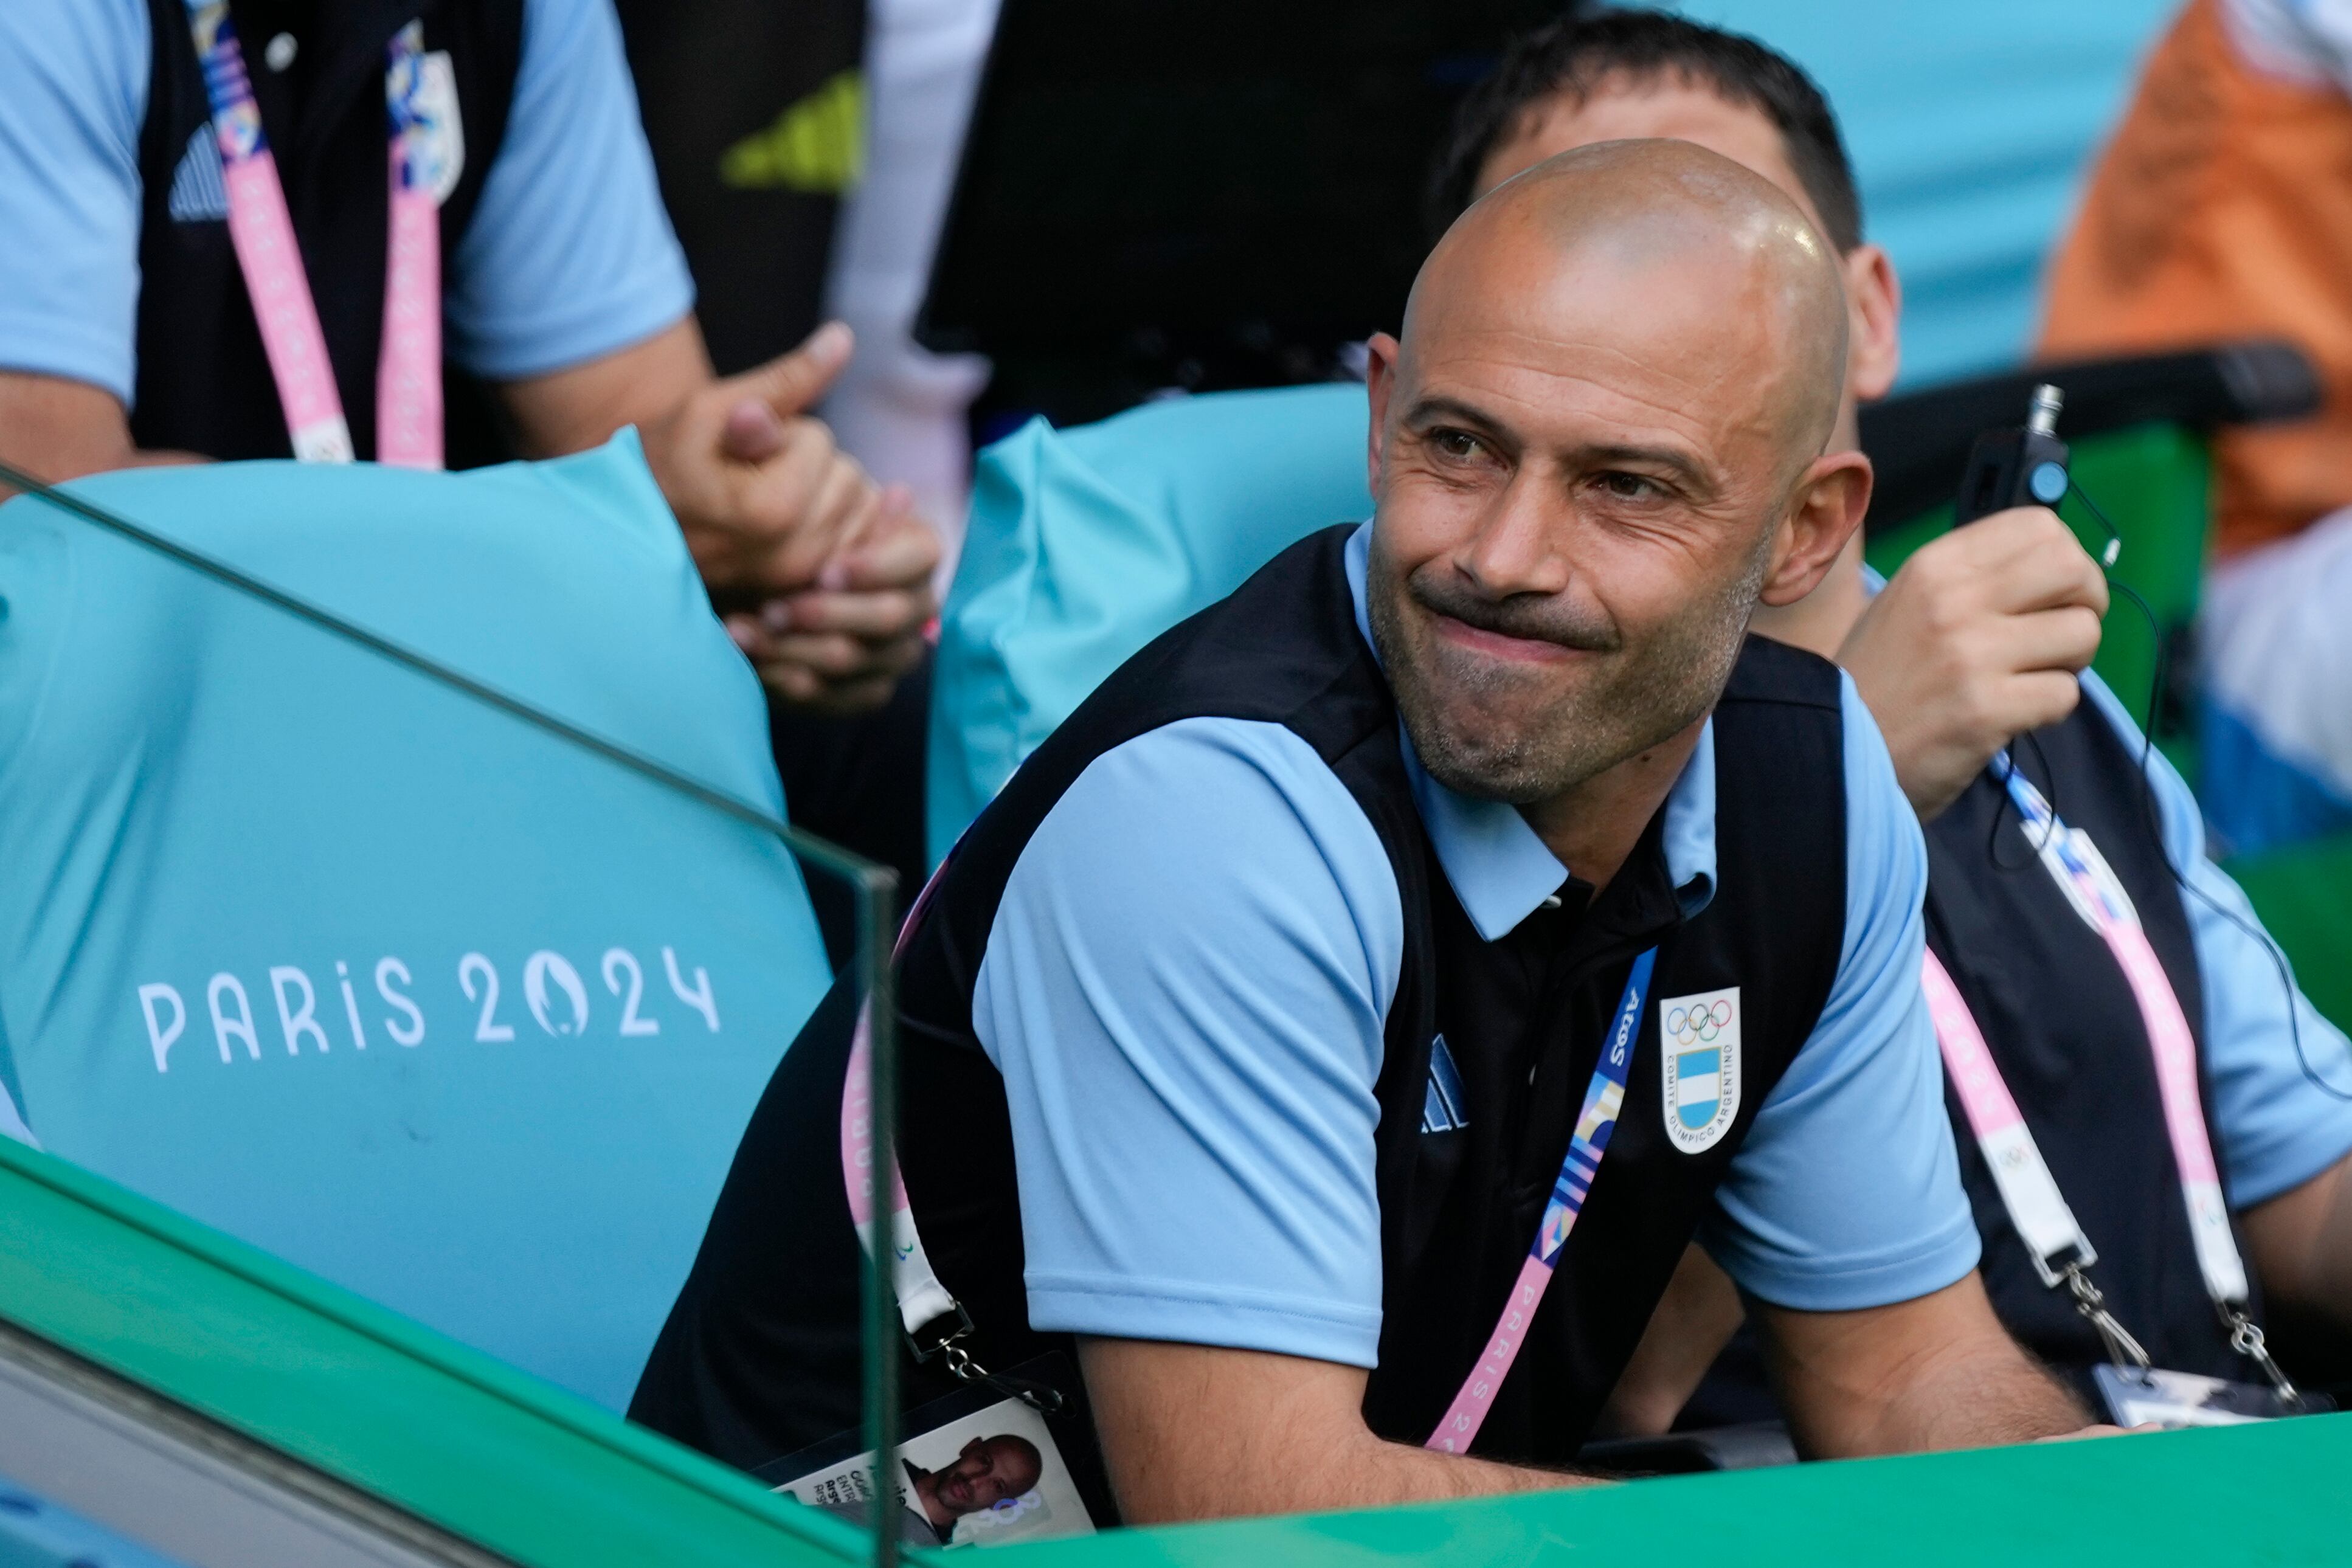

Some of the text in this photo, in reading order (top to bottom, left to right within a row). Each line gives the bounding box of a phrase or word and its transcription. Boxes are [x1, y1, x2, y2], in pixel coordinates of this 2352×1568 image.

[458, 946, 721, 1042] 2024
[1610, 986, 1640, 1068] Atos
[1717, 1045, 1733, 1127] ARGENTINO
[1472, 1284, 1536, 1400] PARIS
